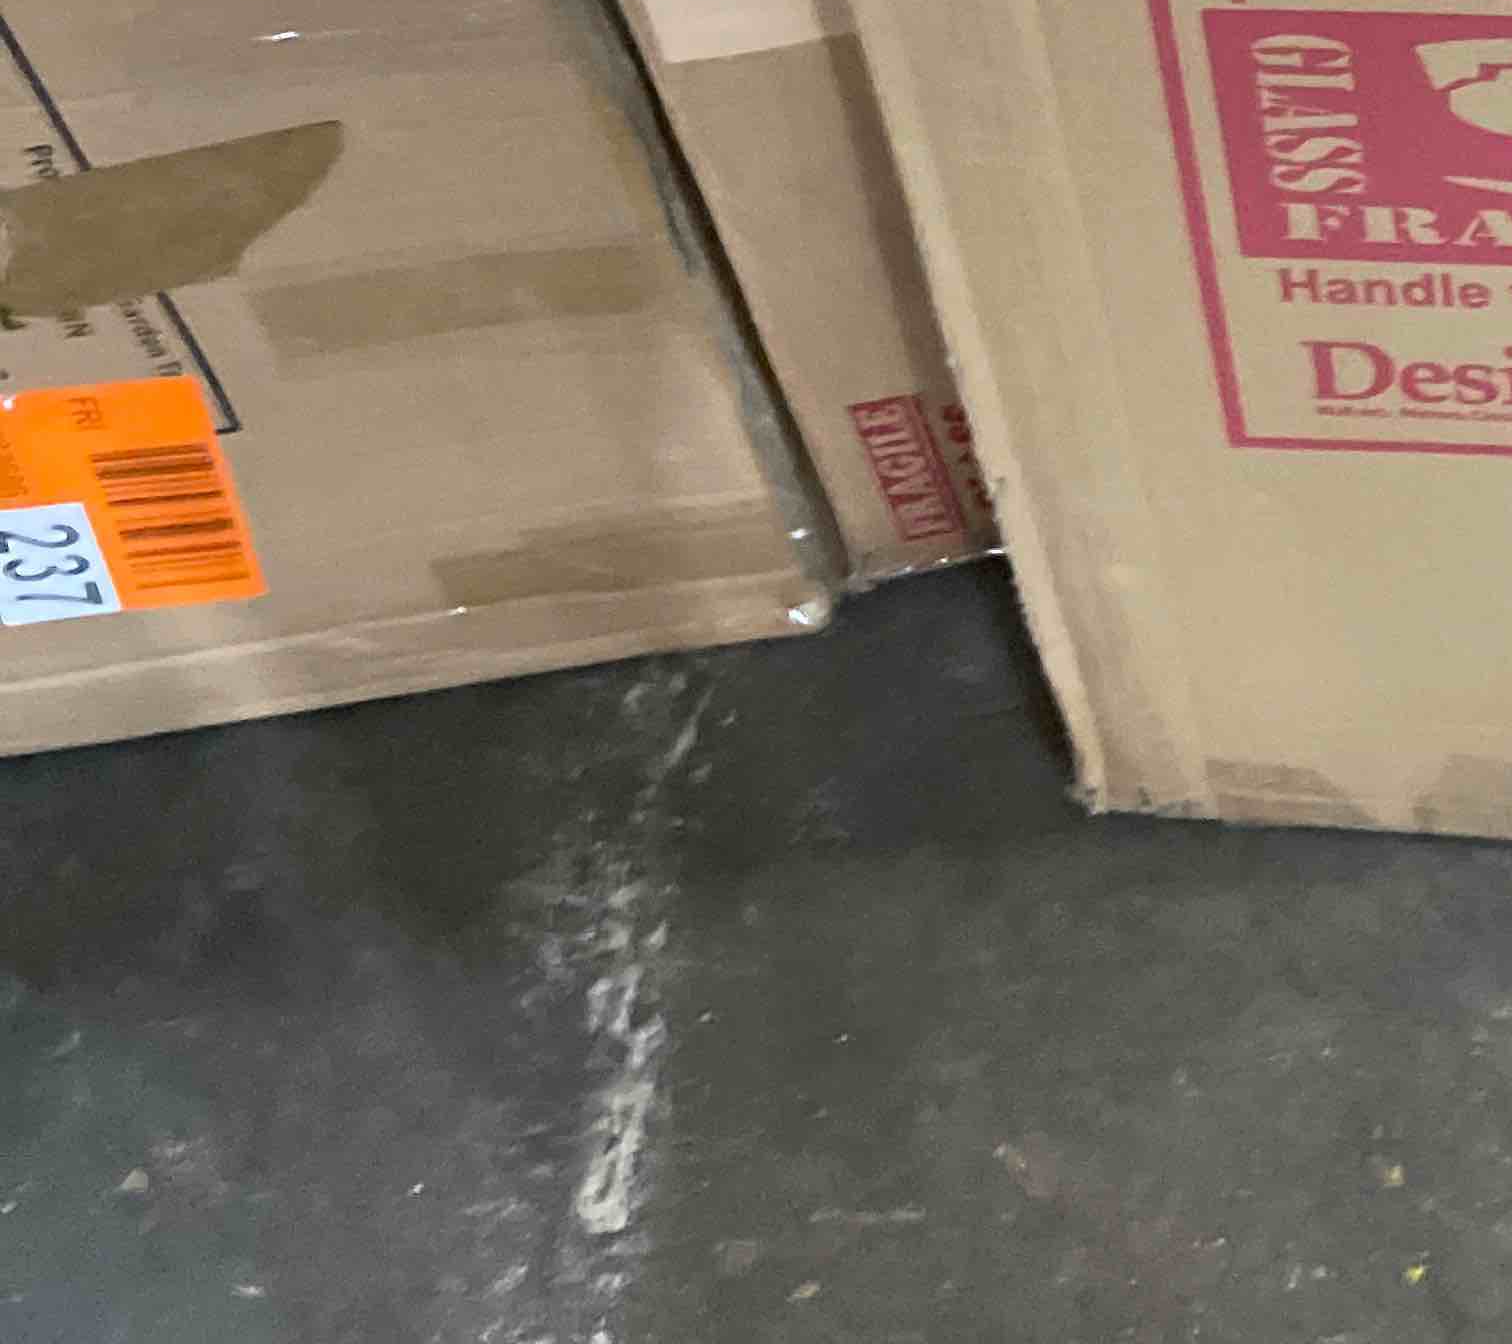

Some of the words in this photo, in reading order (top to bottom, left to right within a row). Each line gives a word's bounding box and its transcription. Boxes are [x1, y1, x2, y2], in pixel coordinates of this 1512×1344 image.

[1251, 33, 1367, 196] GLASS
[1279, 269, 1491, 312] Handle
[0, 523, 103, 605] 237
